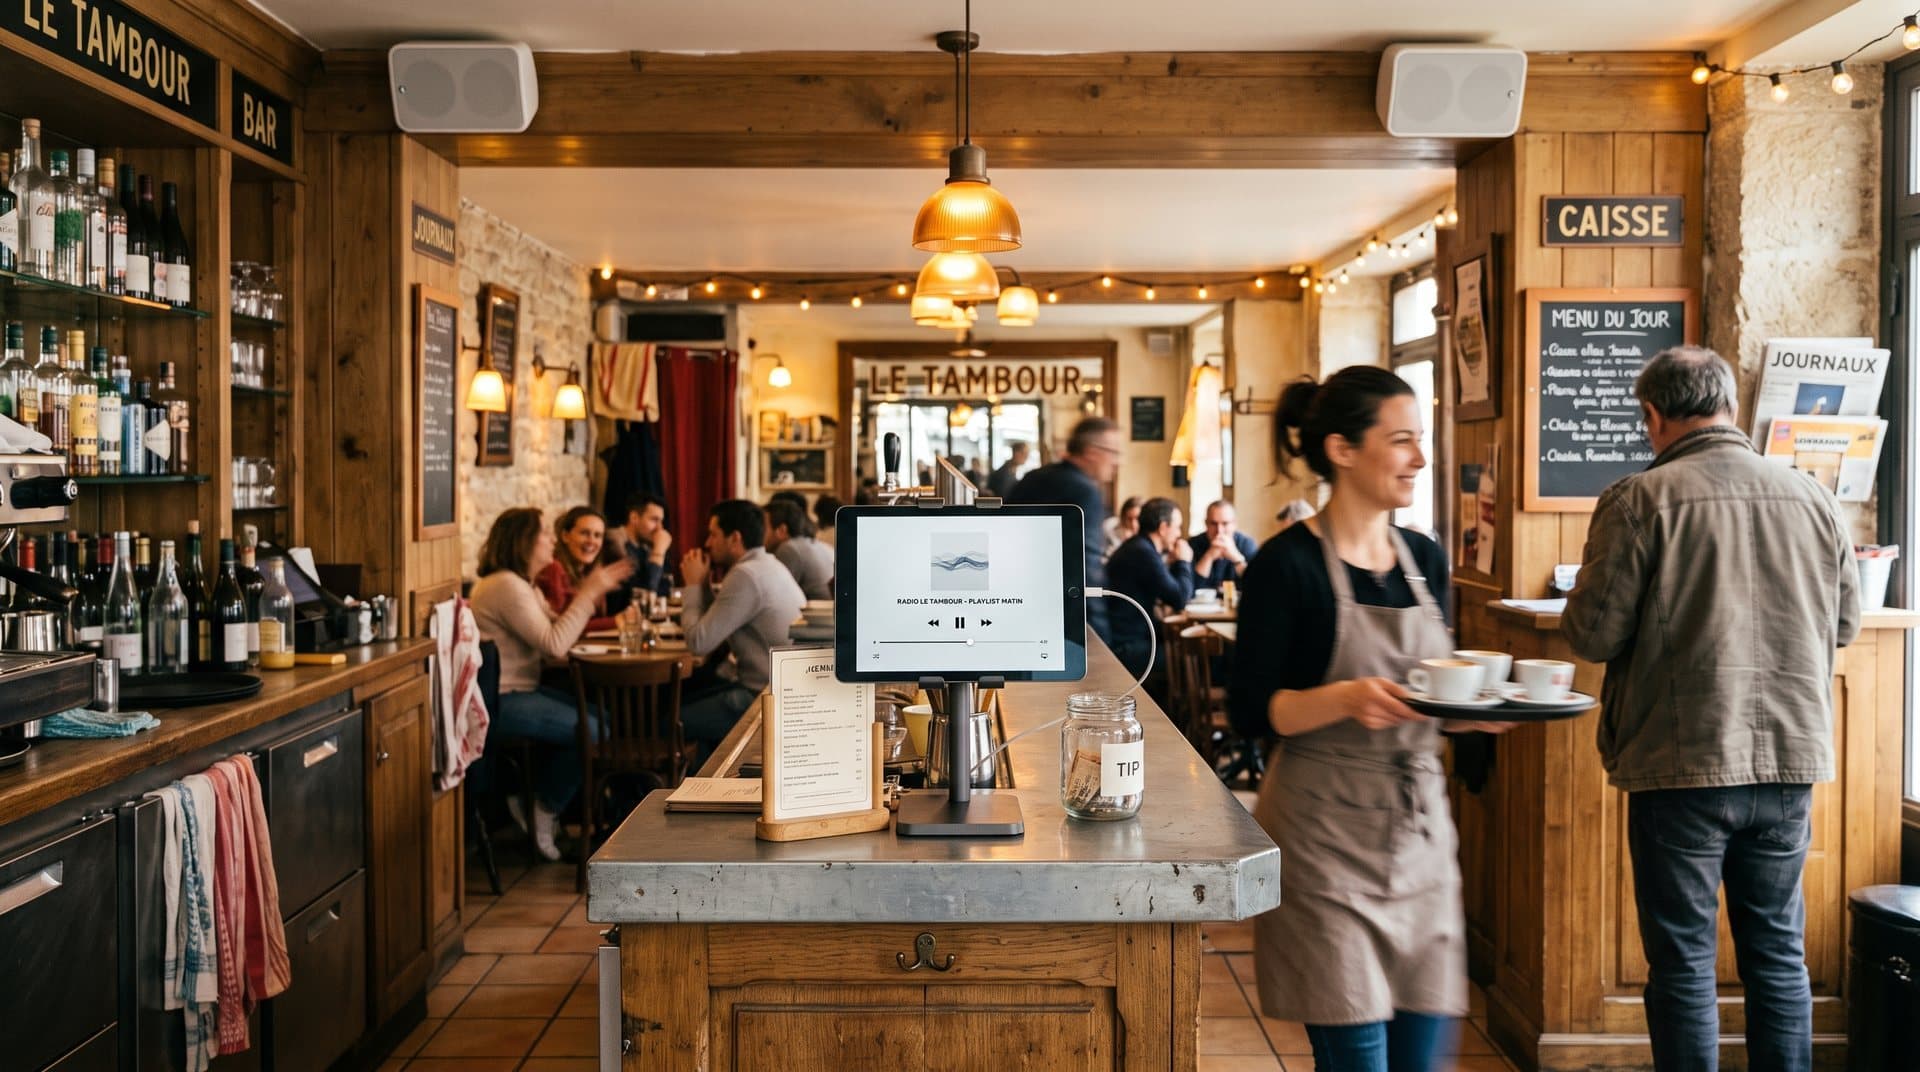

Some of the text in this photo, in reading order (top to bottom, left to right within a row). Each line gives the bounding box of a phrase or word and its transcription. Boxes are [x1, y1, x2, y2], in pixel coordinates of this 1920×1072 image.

[71, 0, 191, 105] TAMBOUR
[243, 92, 277, 150] BAR
[414, 214, 455, 254] JOURNAUX
[1558, 204, 1669, 237] CAISSE
[1551, 307, 1671, 329] MENU DU JOUR
[1771, 351, 1878, 374] JOURNAUX
[870, 365, 1081, 395] LE TAMBOUR
[1116, 760, 1140, 777] TIP
